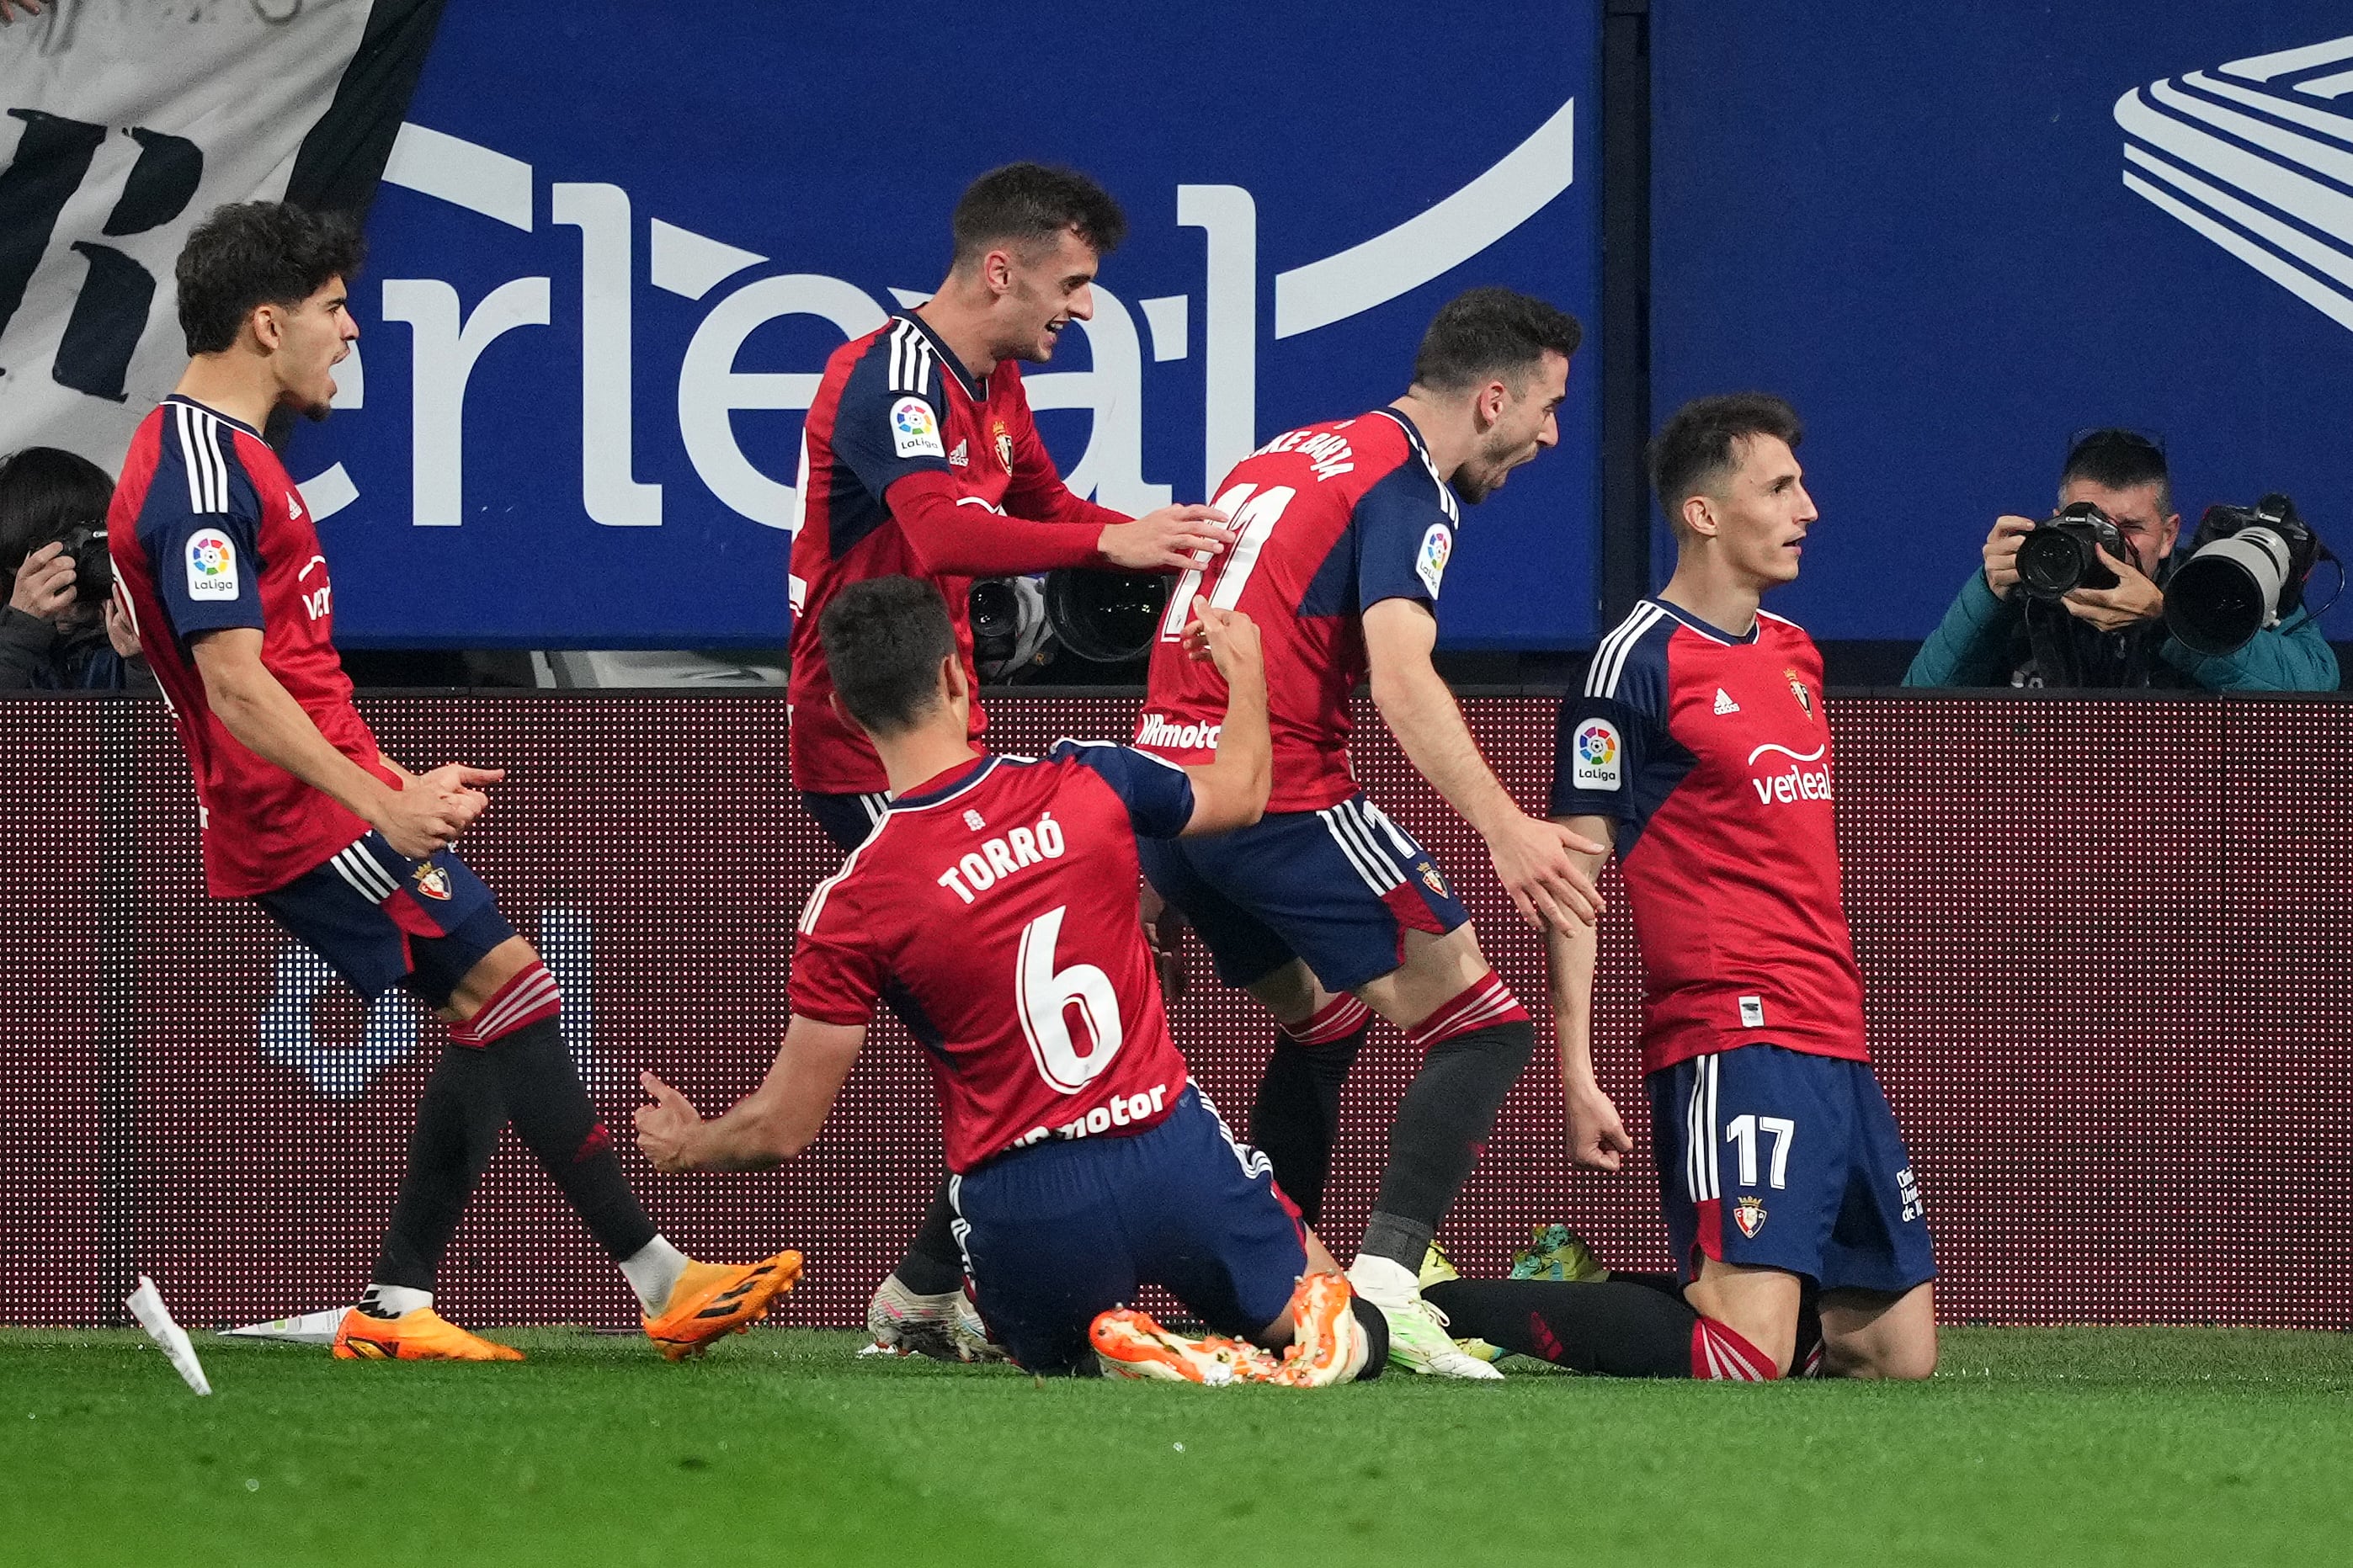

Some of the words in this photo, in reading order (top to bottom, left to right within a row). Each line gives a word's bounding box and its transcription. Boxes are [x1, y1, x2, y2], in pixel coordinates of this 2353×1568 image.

[901, 438, 938, 449] LaLiga
[194, 578, 232, 591] LaLiga
[1579, 768, 1616, 781] LaLiga
[1753, 763, 1832, 805] verleal
[937, 811, 1065, 905] TORRÓ
[1015, 905, 1123, 1095] 6
[1727, 1114, 1795, 1189] 17
